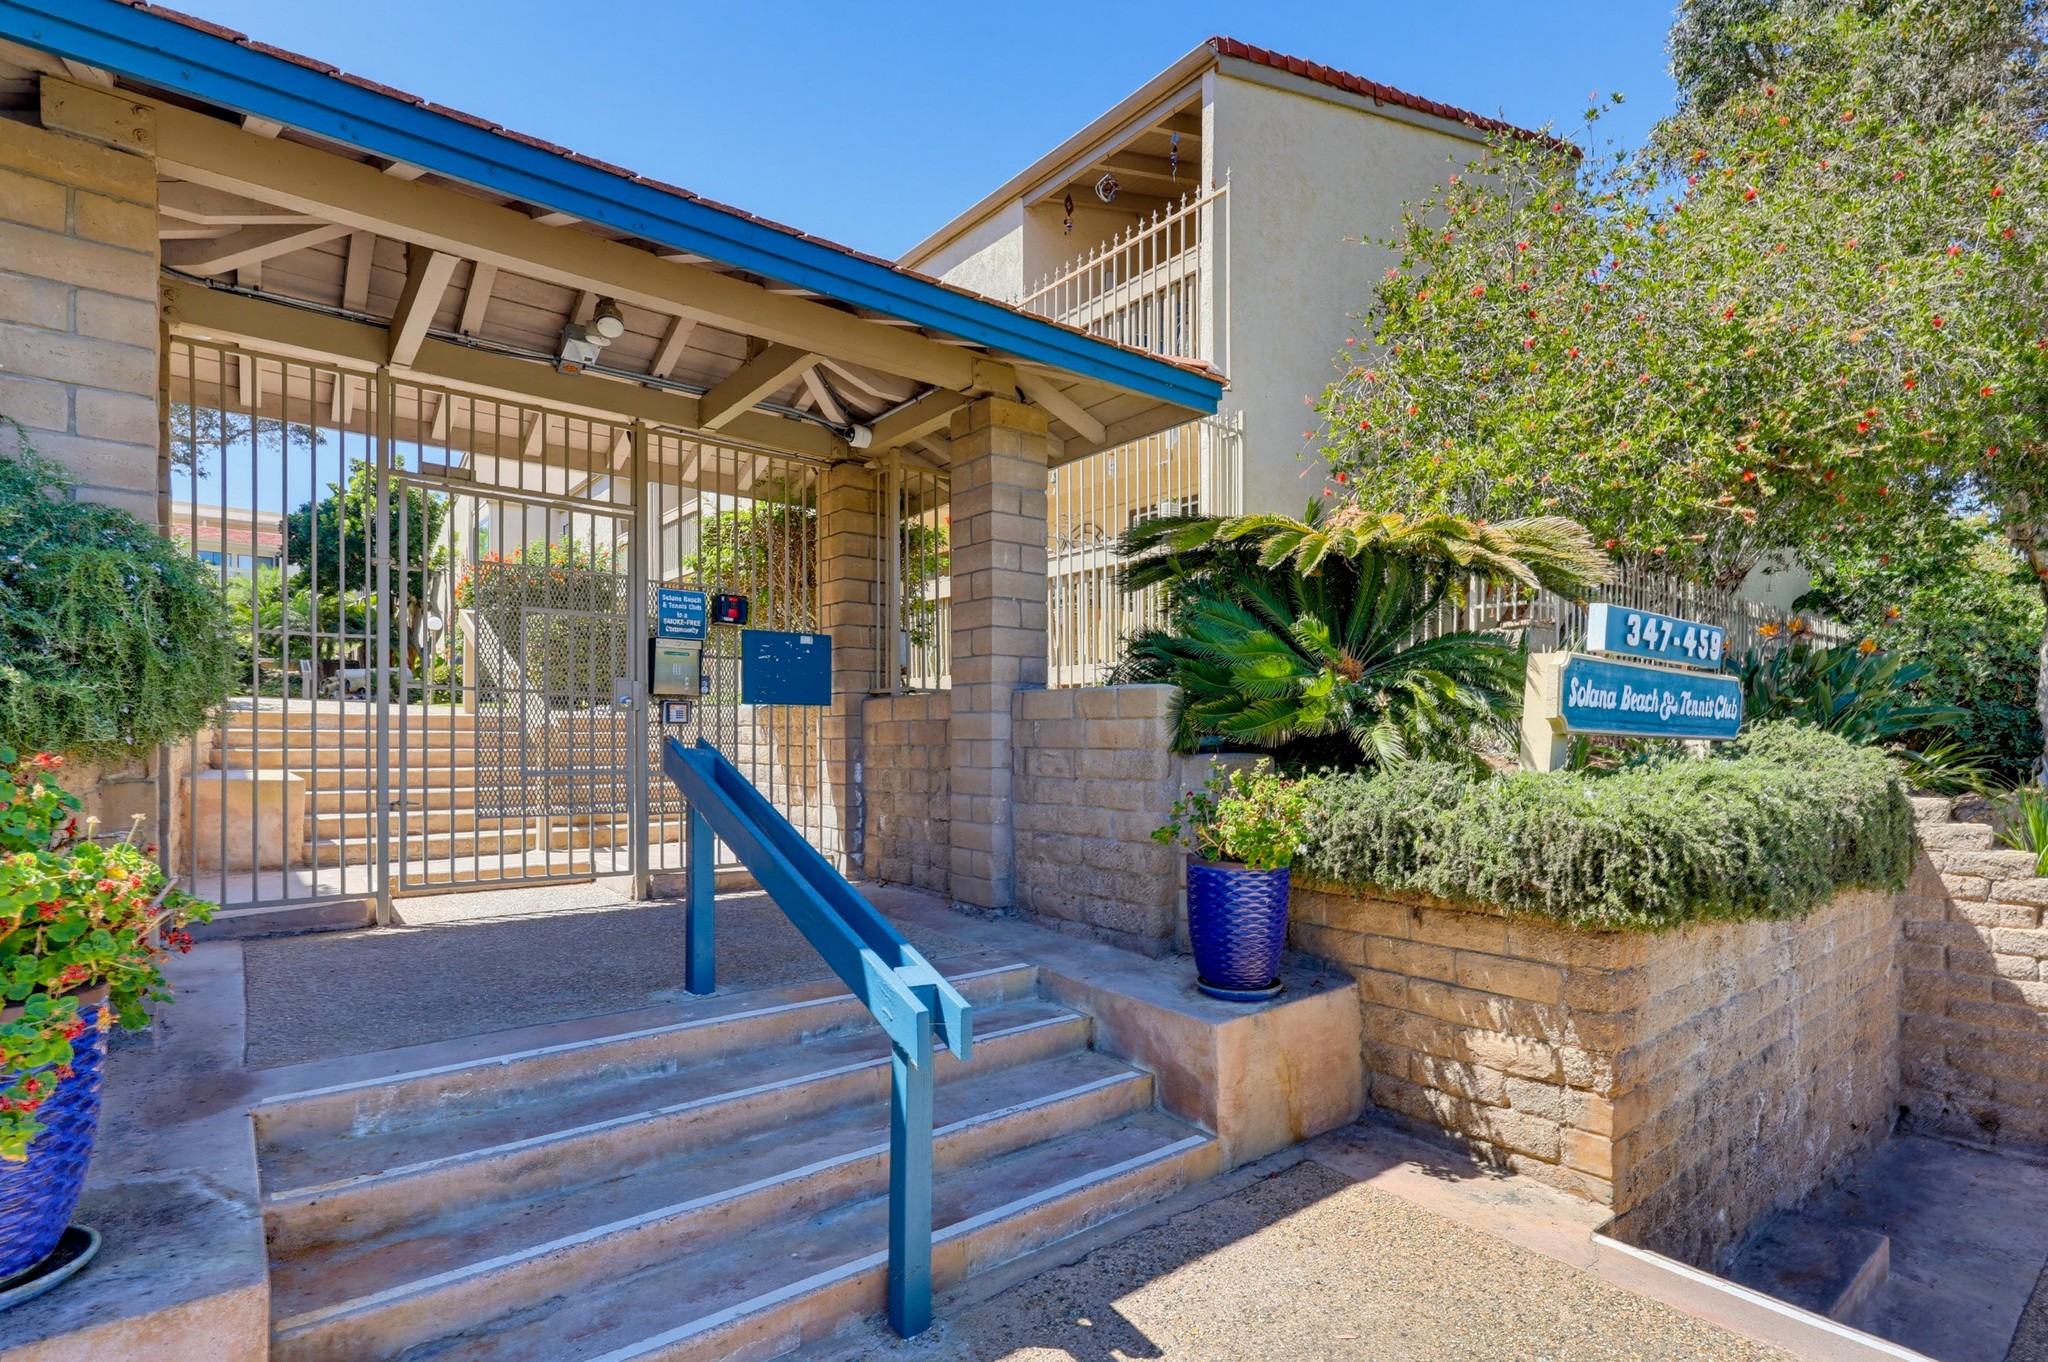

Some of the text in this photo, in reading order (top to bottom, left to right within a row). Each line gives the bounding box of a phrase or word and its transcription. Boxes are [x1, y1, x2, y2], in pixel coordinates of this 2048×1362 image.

[663, 618, 701, 626] SMOKE-FREE
[666, 625, 699, 634] Community
[1626, 613, 1722, 662] 347-459
[1568, 676, 1738, 721] Solana Beach & Tennis Club
